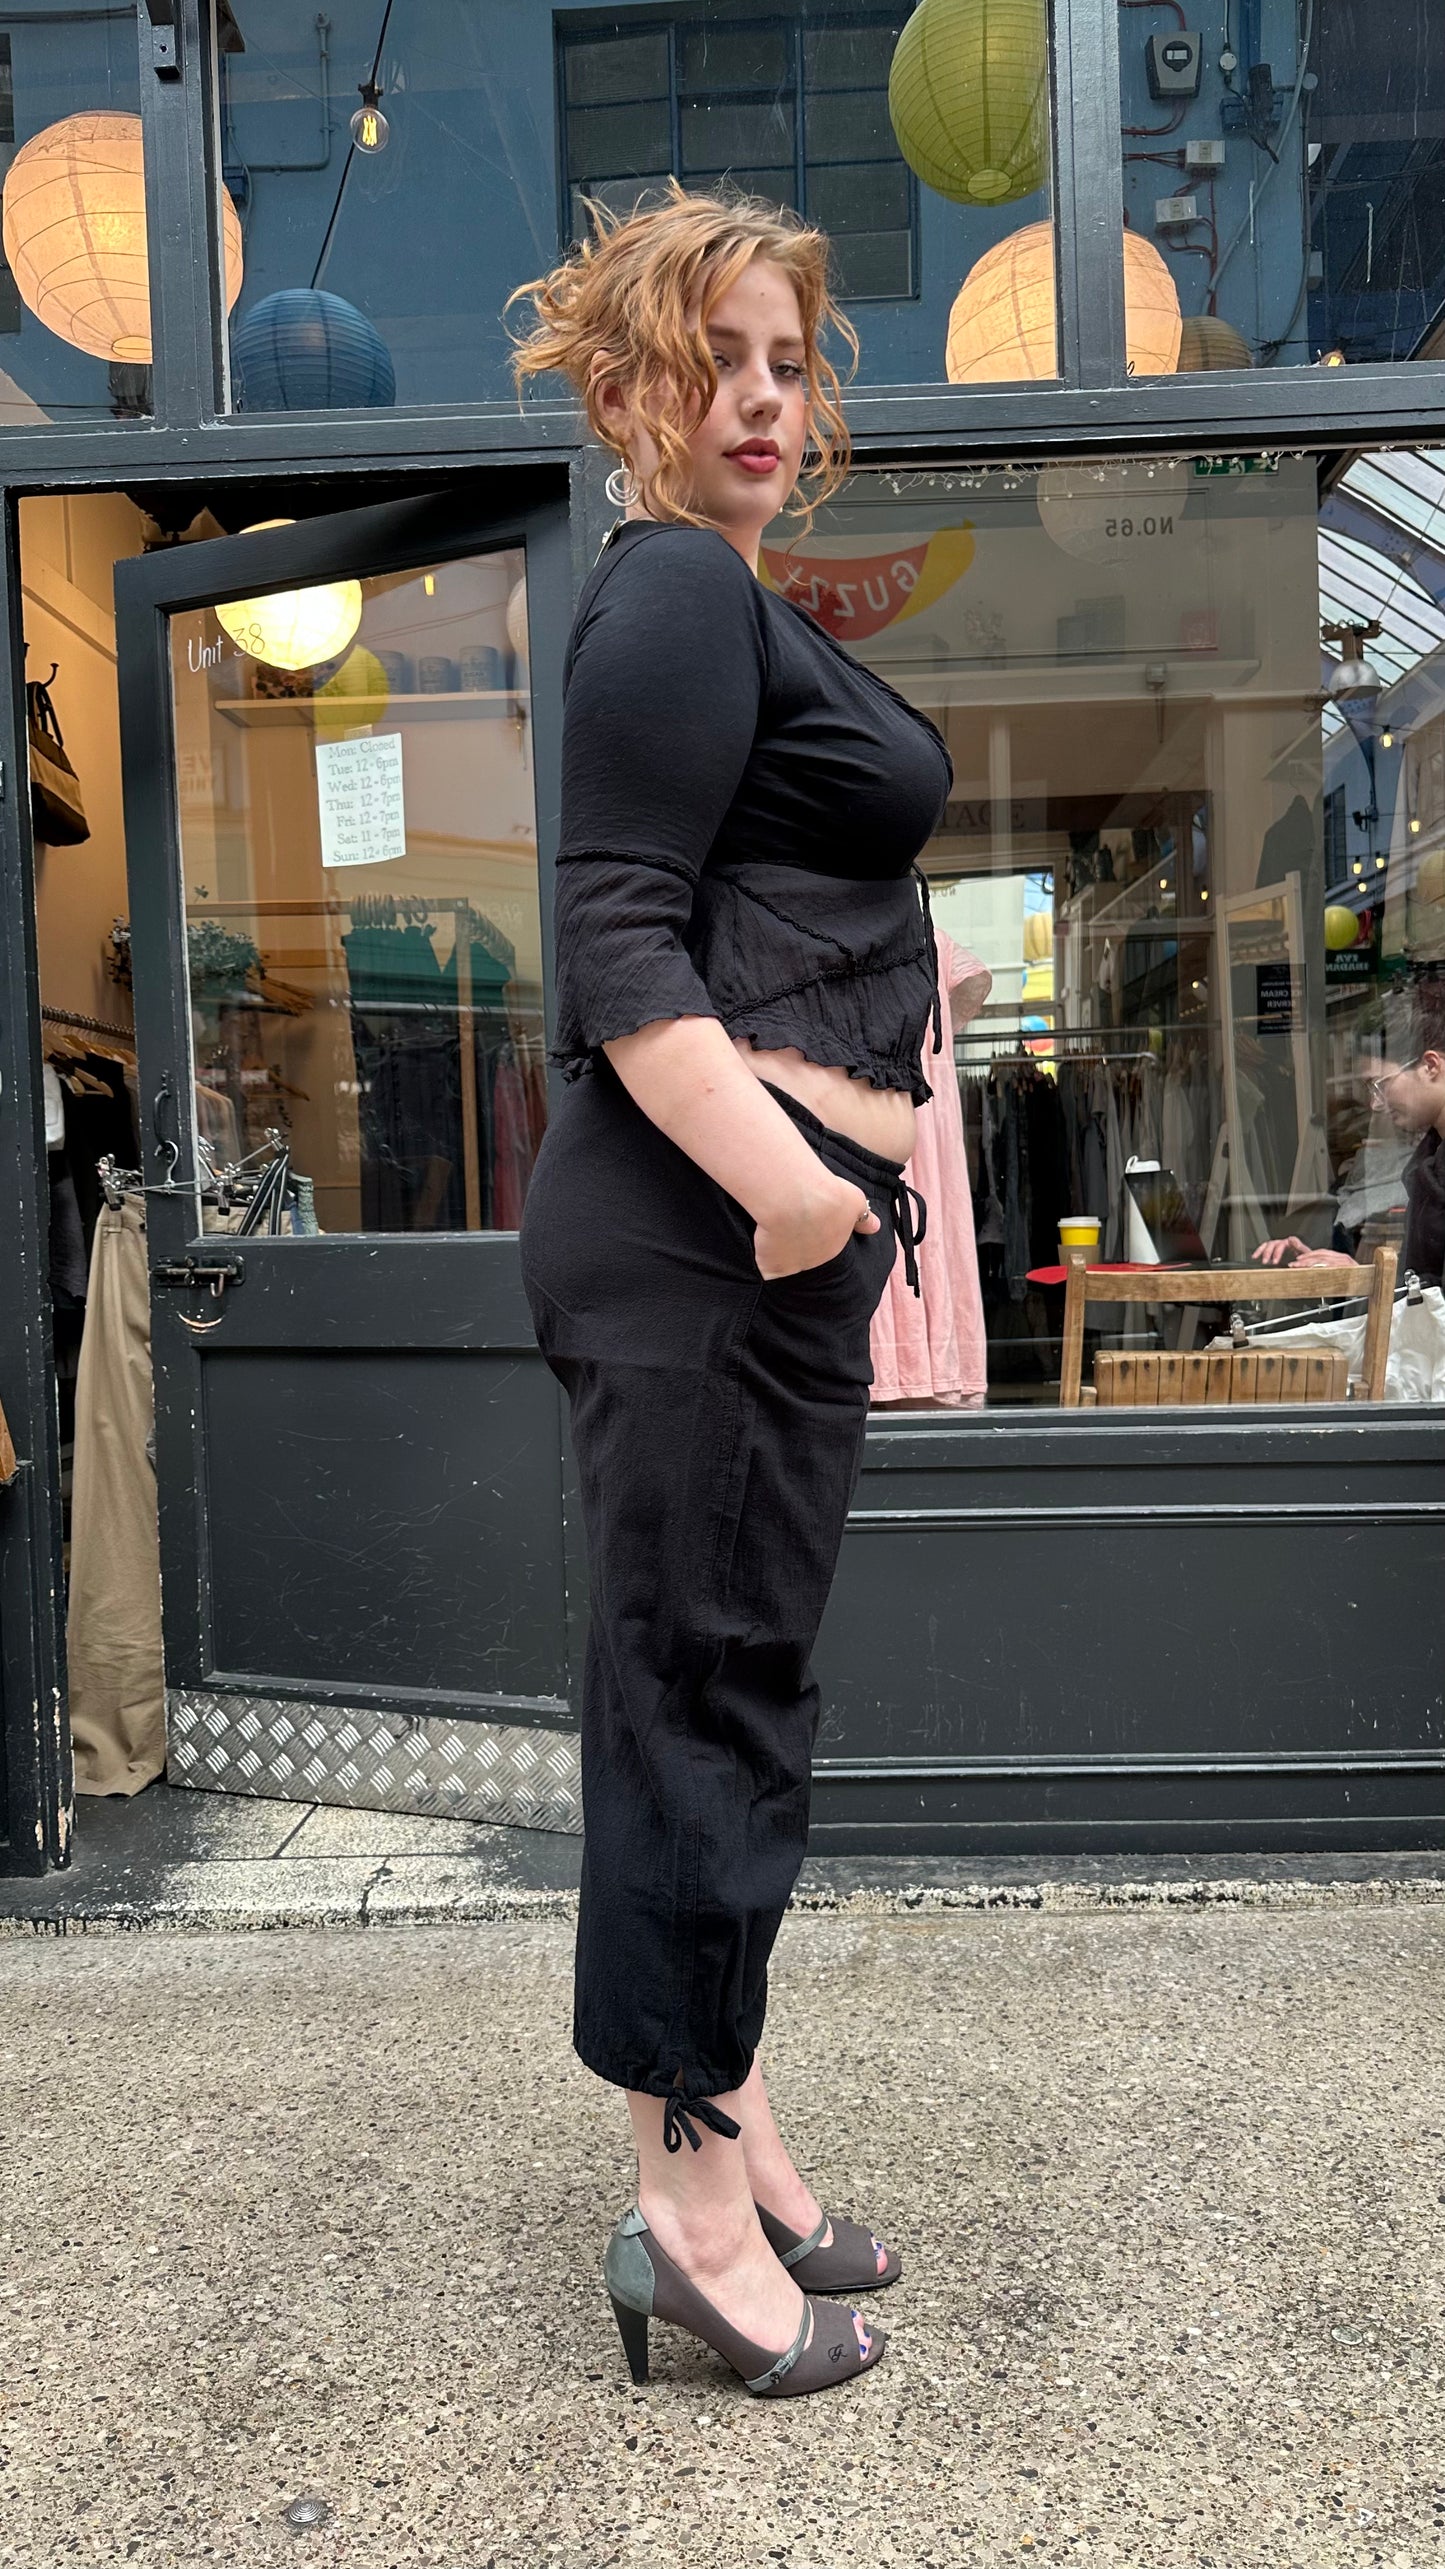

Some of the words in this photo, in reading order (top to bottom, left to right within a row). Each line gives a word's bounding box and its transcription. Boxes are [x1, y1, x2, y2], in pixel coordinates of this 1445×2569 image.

[188, 634, 224, 673] Unit
[232, 623, 266, 657] 38
[328, 746, 357, 759] Mon:
[360, 738, 396, 754] Closed
[328, 764, 353, 776] Tue:
[327, 780, 358, 793] Wed:
[326, 798, 354, 812] Thu:
[336, 814, 356, 828] Fri:
[337, 832, 358, 845] Sat:
[333, 850, 360, 863] Sun:
